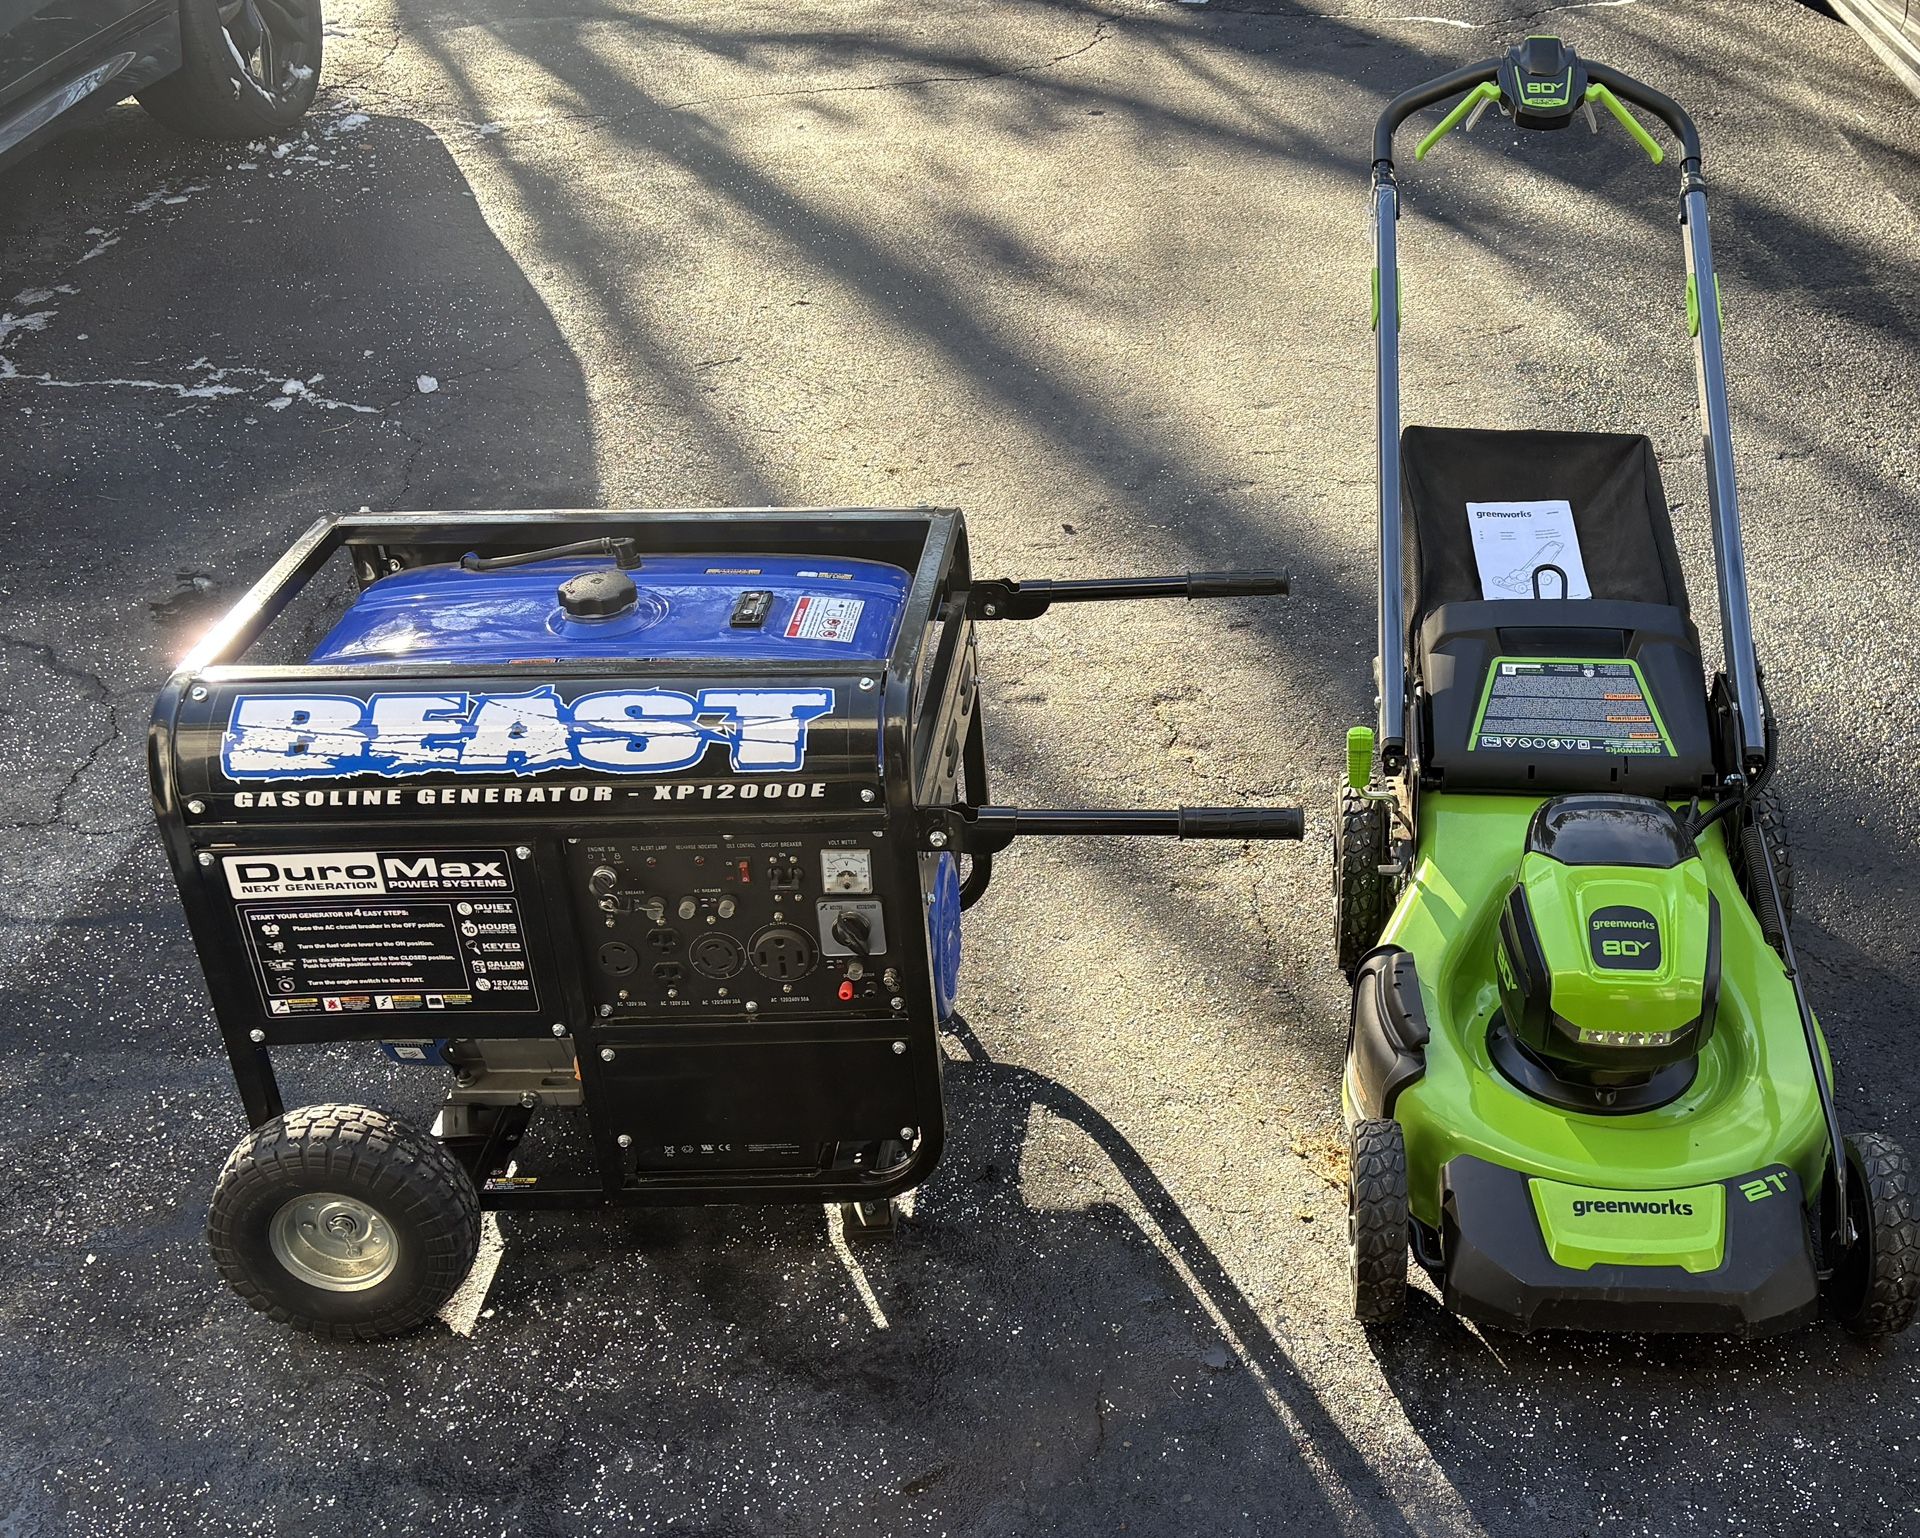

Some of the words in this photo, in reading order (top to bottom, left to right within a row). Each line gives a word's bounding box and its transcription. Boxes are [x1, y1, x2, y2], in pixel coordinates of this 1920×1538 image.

[1476, 510, 1532, 518] greenworks
[220, 684, 835, 781] BEAST
[1605, 746, 1661, 754] greenworks
[234, 790, 401, 807] GASOLINE
[417, 787, 613, 804] GENERATOR
[653, 783, 827, 800] XP12000E
[242, 884, 281, 893] NEXT
[285, 881, 378, 892] GENERATION
[389, 880, 439, 888] POWER
[443, 879, 507, 887] SYSTEMS
[299, 911, 343, 919] GENERATOR
[354, 908, 361, 916] 4
[464, 926, 475, 934] 10
[1593, 919, 1656, 931] greenworks
[1572, 1199, 1693, 1216] greenworks
